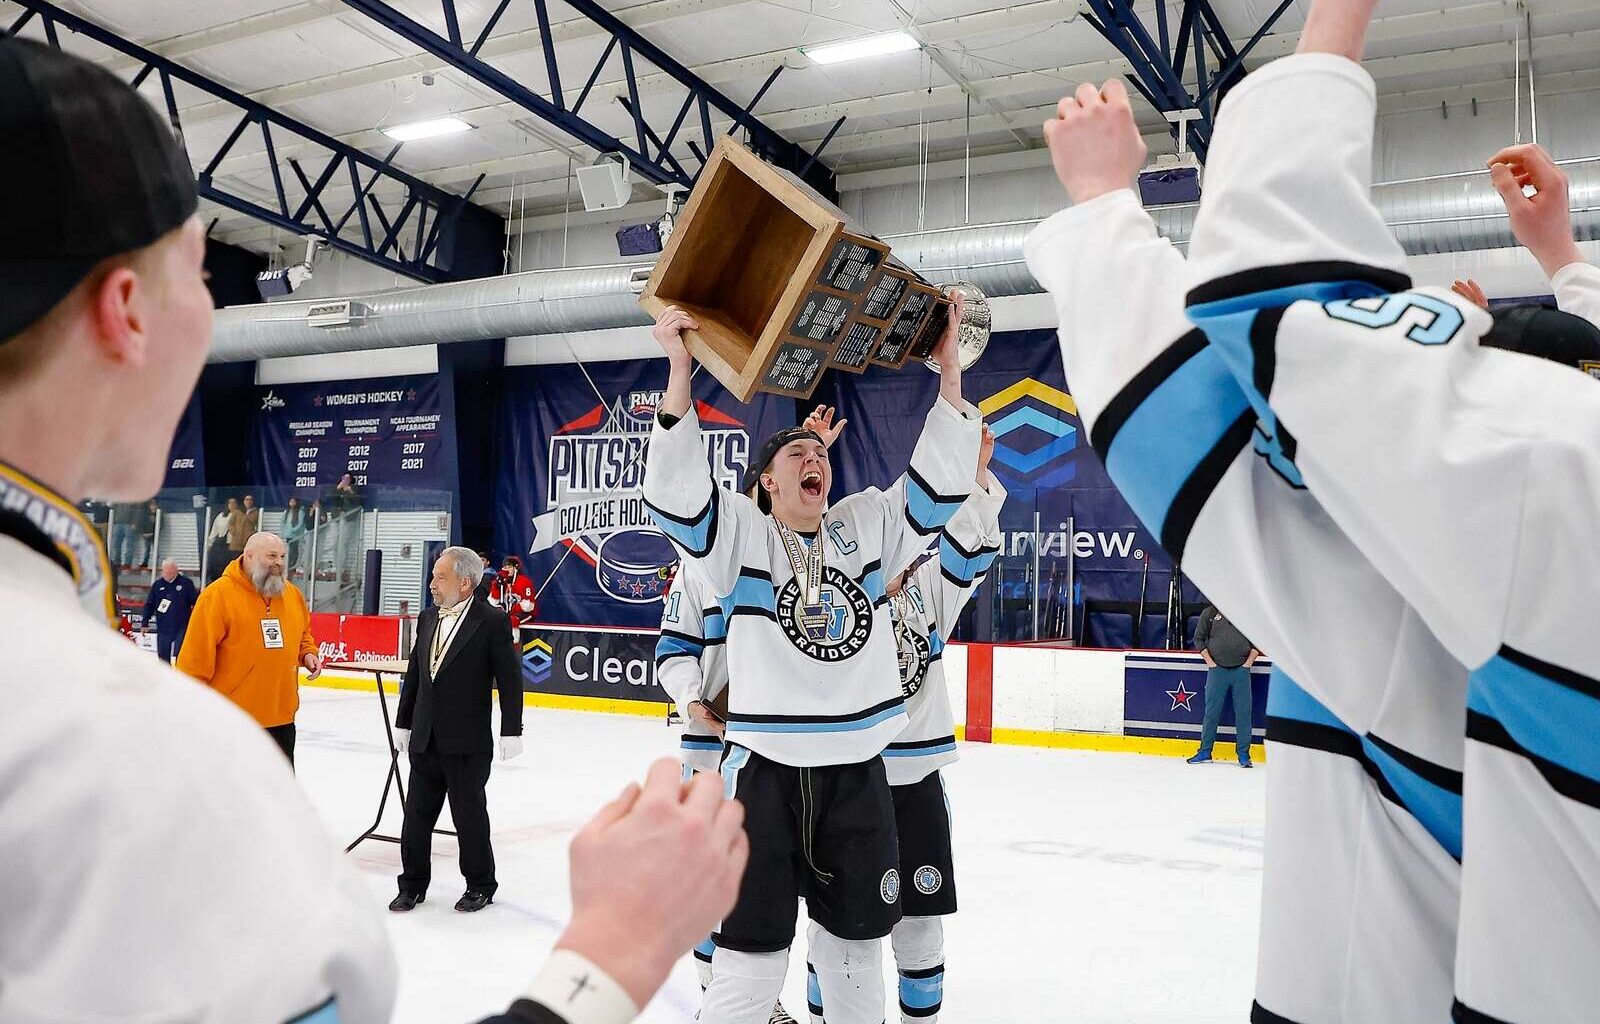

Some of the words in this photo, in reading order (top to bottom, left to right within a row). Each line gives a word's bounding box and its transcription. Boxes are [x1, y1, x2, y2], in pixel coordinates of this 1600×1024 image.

[326, 393, 366, 406] WOMEN'S
[367, 391, 403, 403] HOCKEY
[344, 419, 380, 427] TOURNAMENT
[396, 423, 435, 431] APPEARANCES
[345, 426, 377, 434] CHAMPIONS
[298, 447, 318, 458] 2017
[349, 445, 370, 456] 2012
[403, 443, 425, 454] 2017
[297, 462, 317, 473] 2018
[348, 460, 368, 471] 2017
[402, 458, 423, 469] 2021
[295, 476, 316, 487] 2019
[354, 475, 367, 485] 21
[560, 500, 615, 535] COLLEGE
[828, 521, 858, 555] C
[780, 583, 800, 627] SENE
[825, 569, 870, 616] VALLEY
[663, 591, 681, 623] 1
[796, 628, 867, 660] RAIDERS
[354, 650, 397, 662] Robinson
